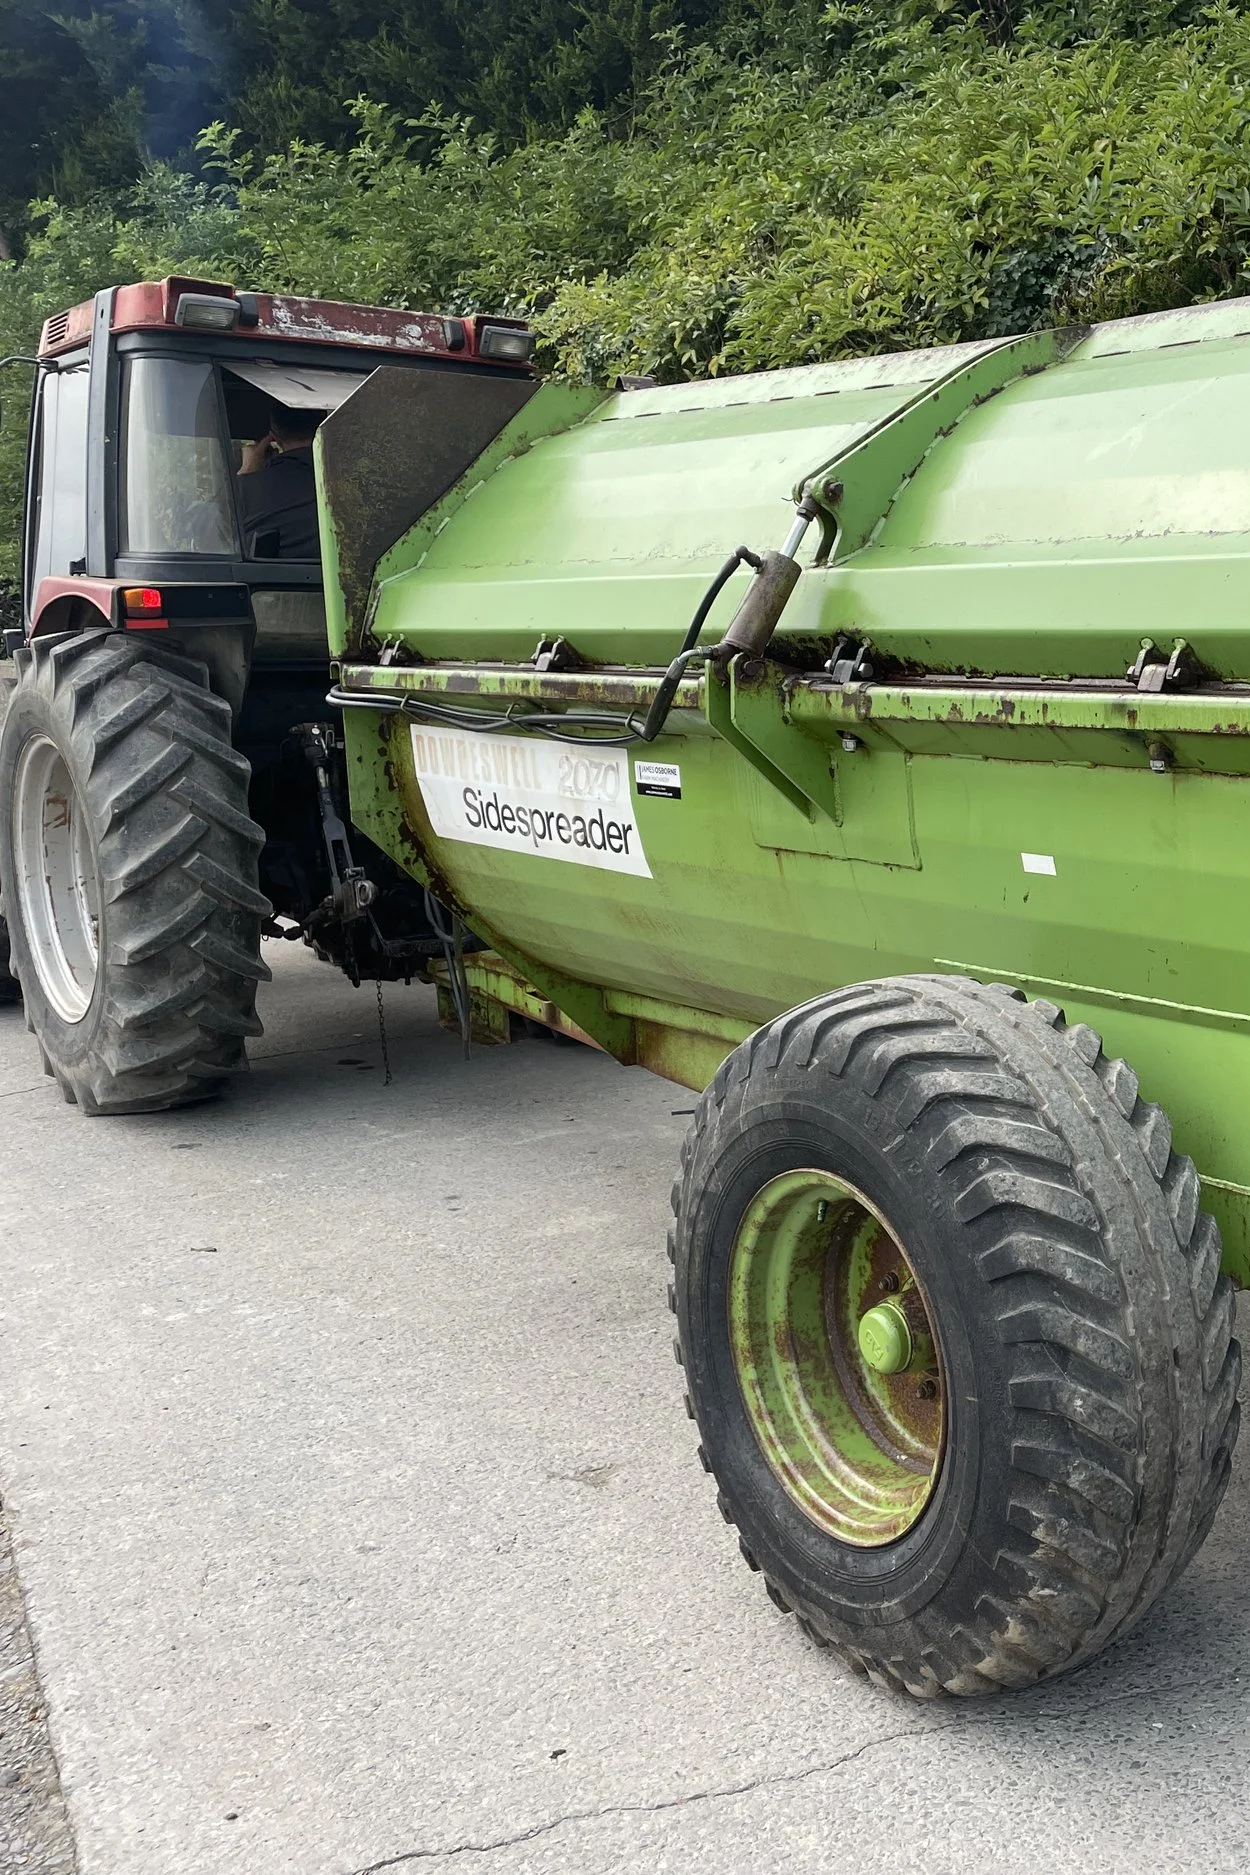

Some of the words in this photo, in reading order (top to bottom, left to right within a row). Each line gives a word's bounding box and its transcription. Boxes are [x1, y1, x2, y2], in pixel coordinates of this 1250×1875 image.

[557, 754, 620, 801] 2070
[642, 765, 655, 774] JAMES
[655, 766, 678, 776] OSBORNE
[462, 786, 633, 855] Sidespreader
